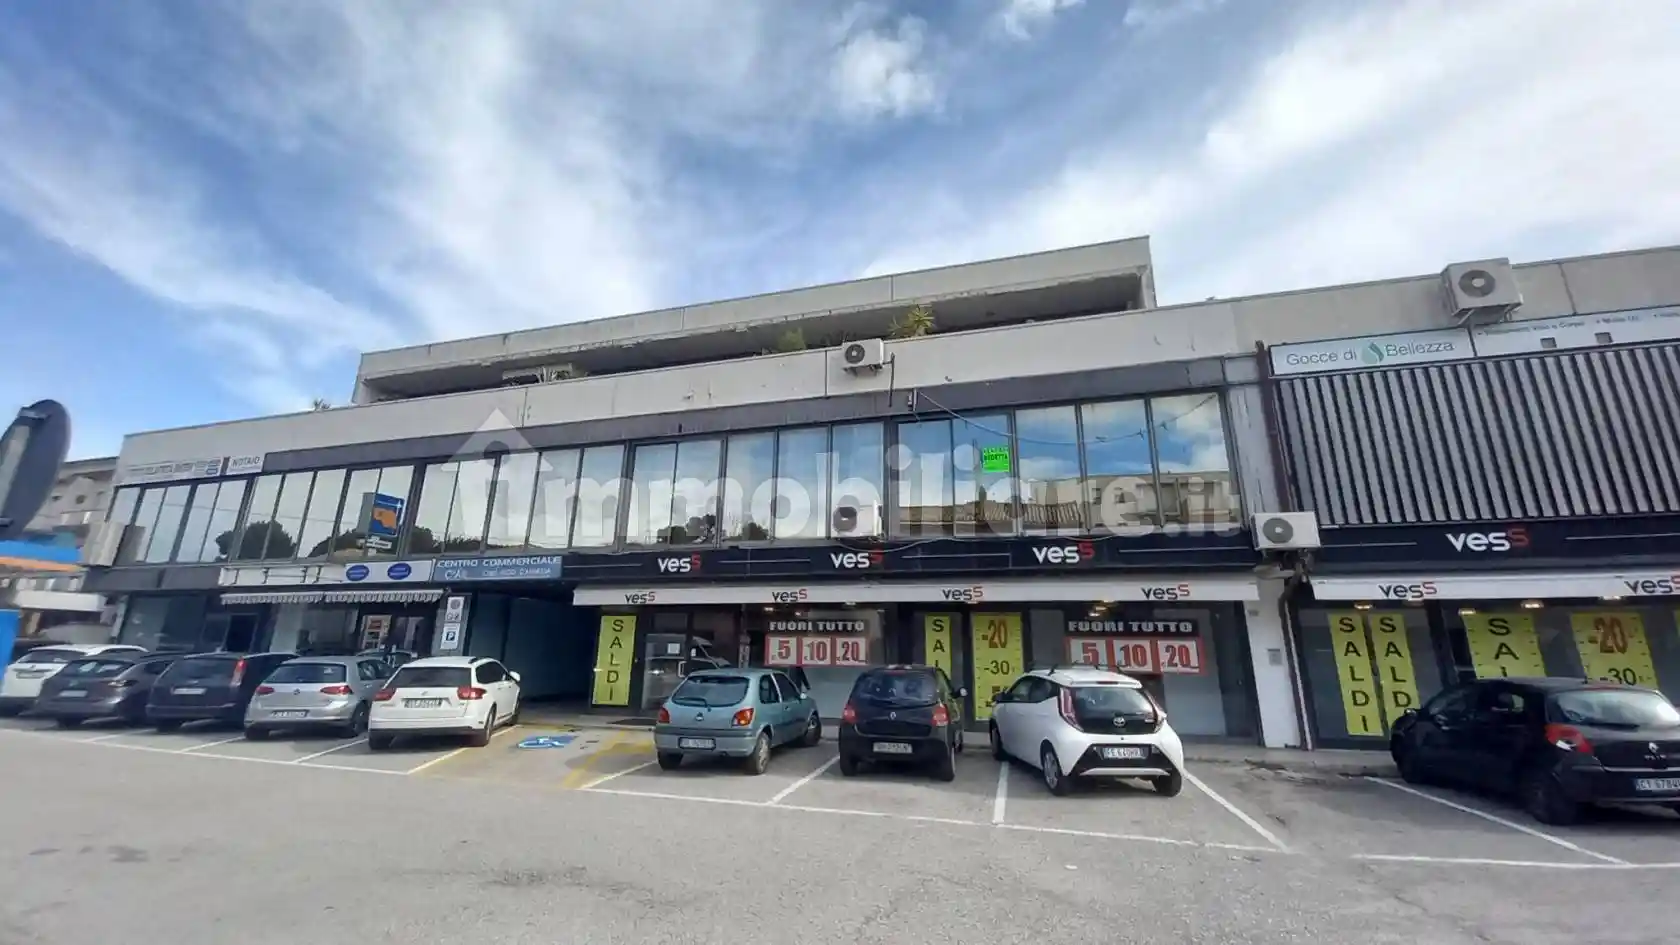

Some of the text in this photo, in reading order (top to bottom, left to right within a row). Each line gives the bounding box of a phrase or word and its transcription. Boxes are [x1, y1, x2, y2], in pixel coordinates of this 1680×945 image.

[1286, 339, 1455, 367] Gocce di Bellezza
[437, 555, 560, 569] CENTRO COMMERCIALE
[769, 620, 864, 632] FUORI TUTTO
[1068, 621, 1193, 633] FUORI TUTTO
[606, 619, 625, 701] SALDI
[1339, 617, 1370, 732] SALDI
